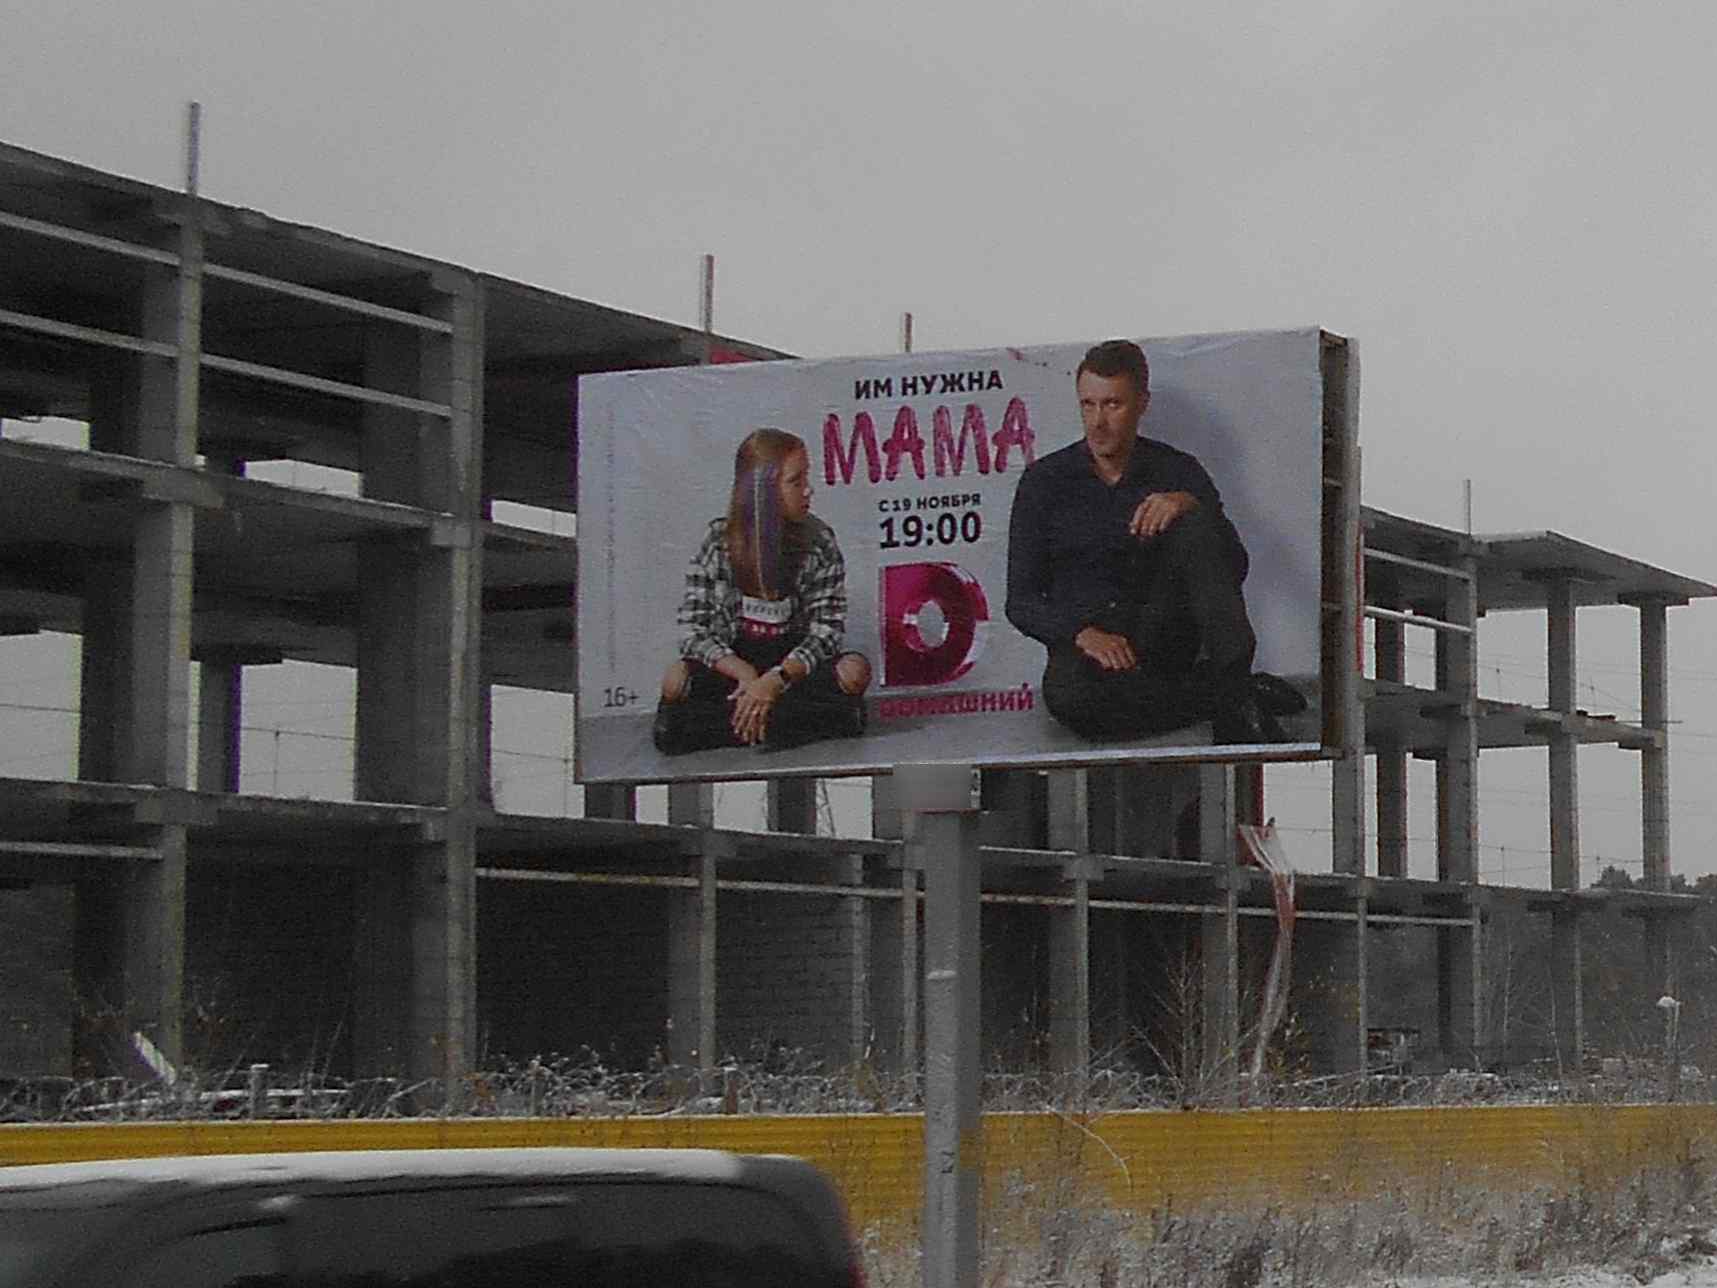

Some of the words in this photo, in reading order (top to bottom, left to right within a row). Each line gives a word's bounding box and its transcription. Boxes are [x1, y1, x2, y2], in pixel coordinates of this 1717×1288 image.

[855, 376, 893, 400] ИМ
[901, 369, 1003, 397] НУЖНА
[822, 395, 1036, 486] МАМА
[878, 499, 888, 512] С
[892, 497, 912, 512] 19
[916, 492, 982, 510] НОЯБРЯ
[879, 511, 982, 550] 19:00
[603, 686, 641, 708] 16+
